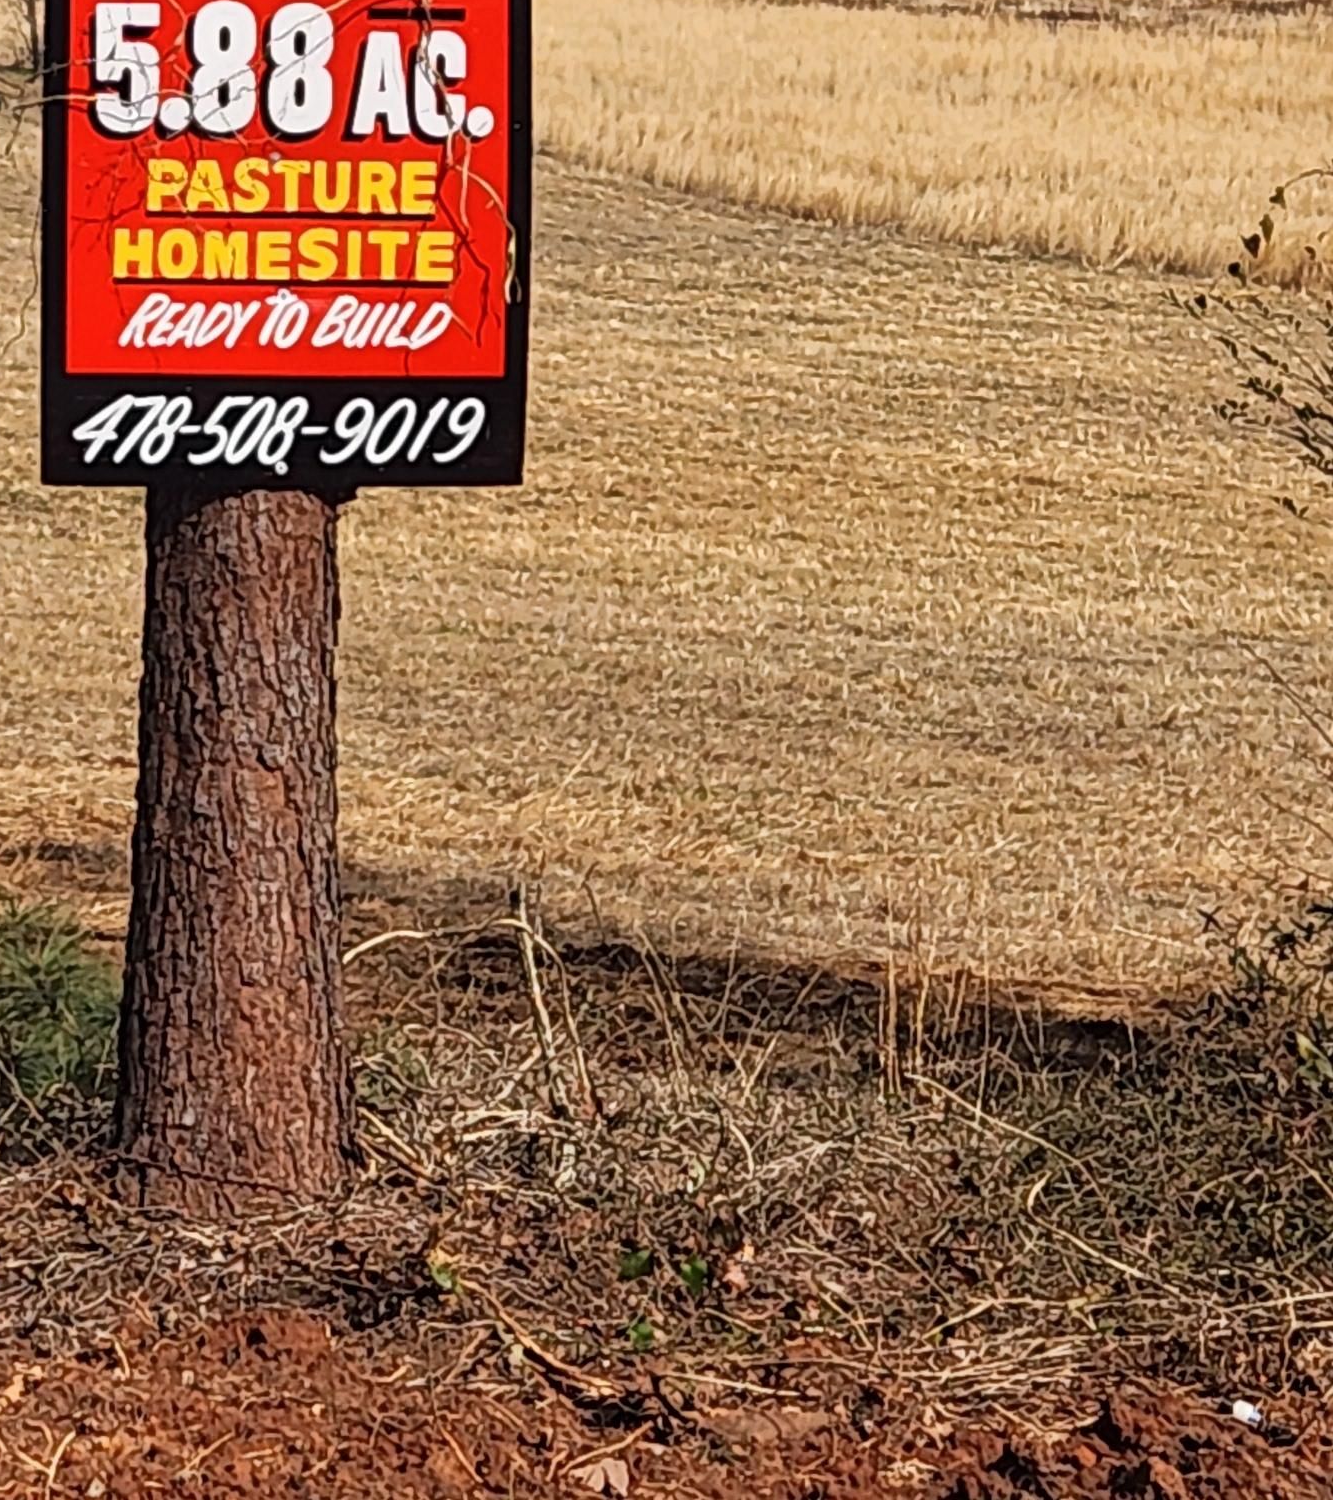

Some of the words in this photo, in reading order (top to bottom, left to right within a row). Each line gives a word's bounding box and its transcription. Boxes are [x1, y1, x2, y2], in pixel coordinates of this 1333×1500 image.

[94, 0, 335, 134] 5.88
[351, 30, 494, 137] AC.
[146, 158, 438, 214] PASTURE
[112, 228, 456, 282] HOMESITE
[118, 294, 252, 349] READY
[258, 296, 308, 349] TO
[311, 294, 452, 349] BUILD
[73, 394, 486, 466] 478-508-9019
